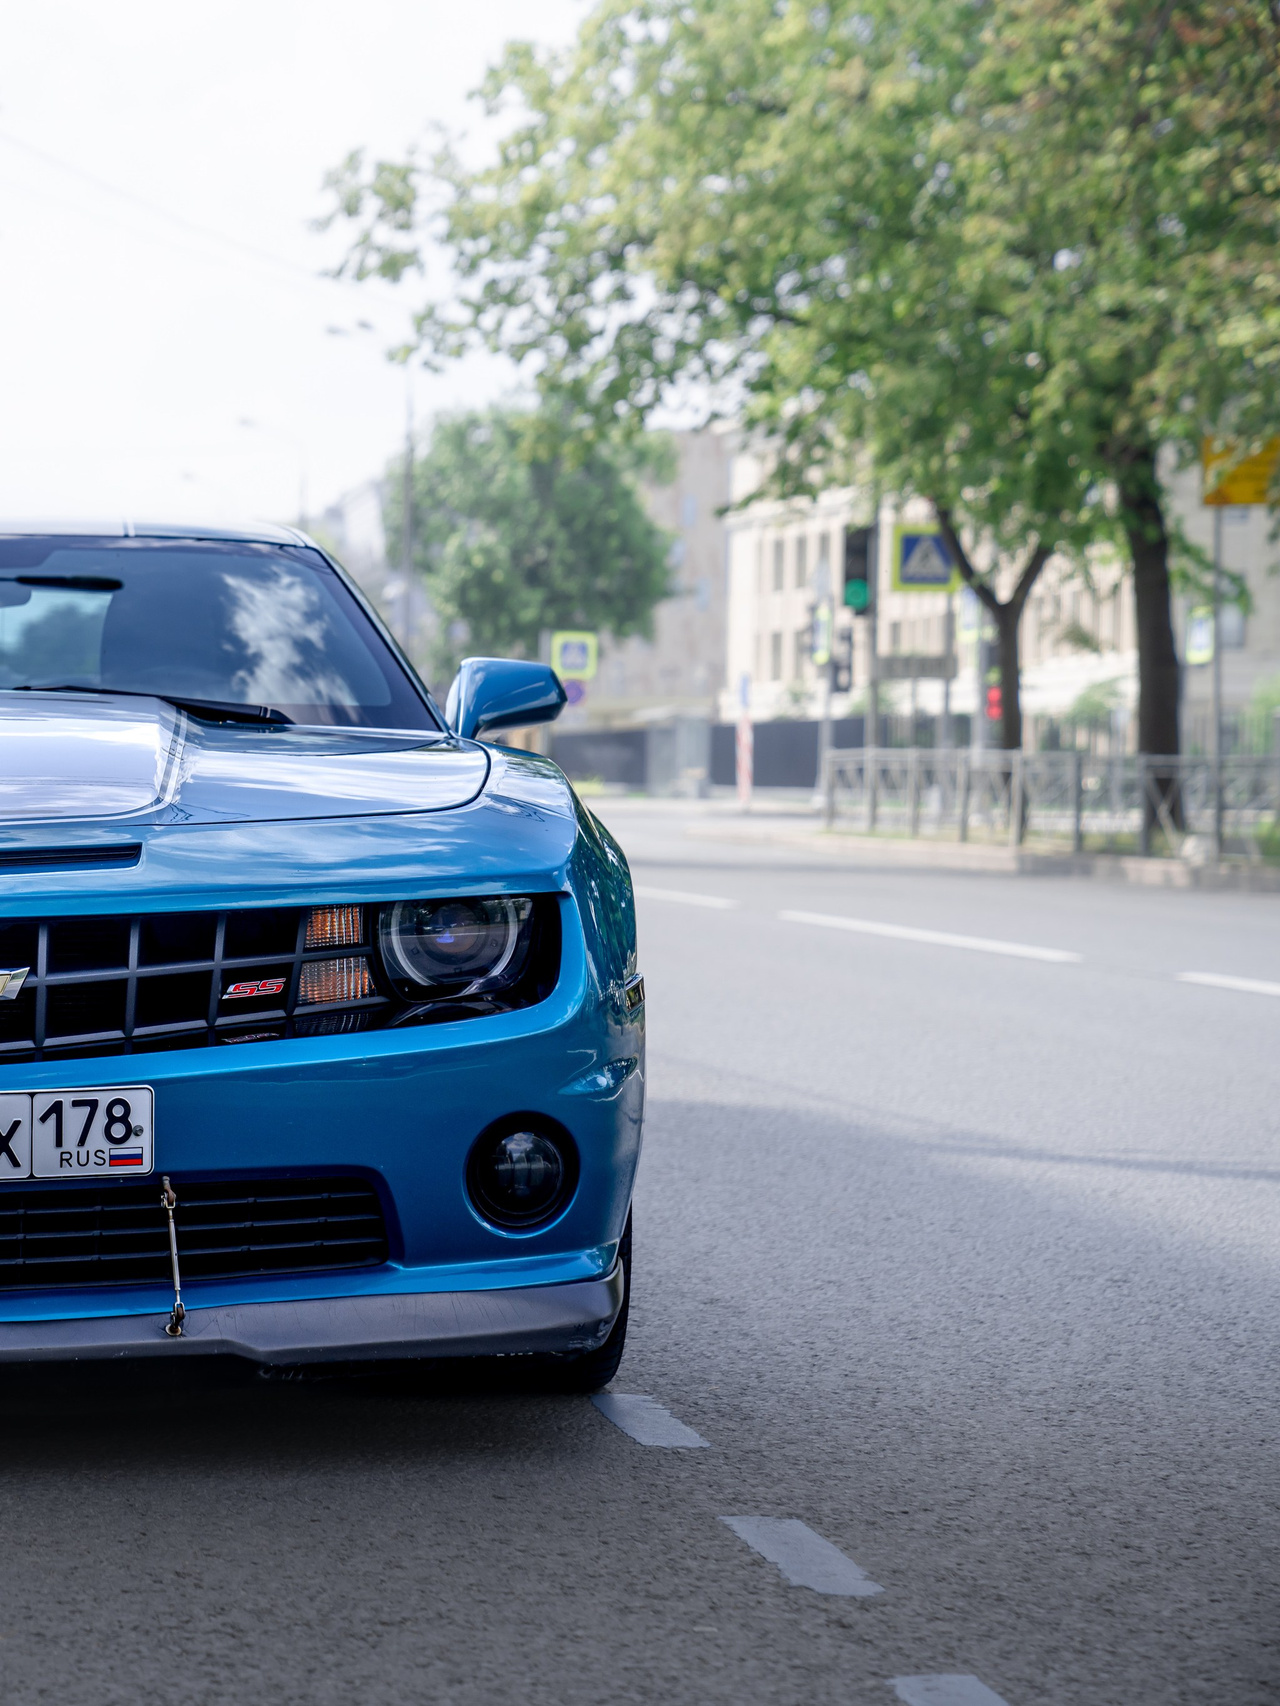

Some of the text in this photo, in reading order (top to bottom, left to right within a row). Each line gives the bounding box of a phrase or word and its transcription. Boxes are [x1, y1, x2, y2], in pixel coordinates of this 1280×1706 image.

[222, 978, 286, 999] SS
[38, 1098, 132, 1148] 178
[59, 1149, 107, 1168] RUS
